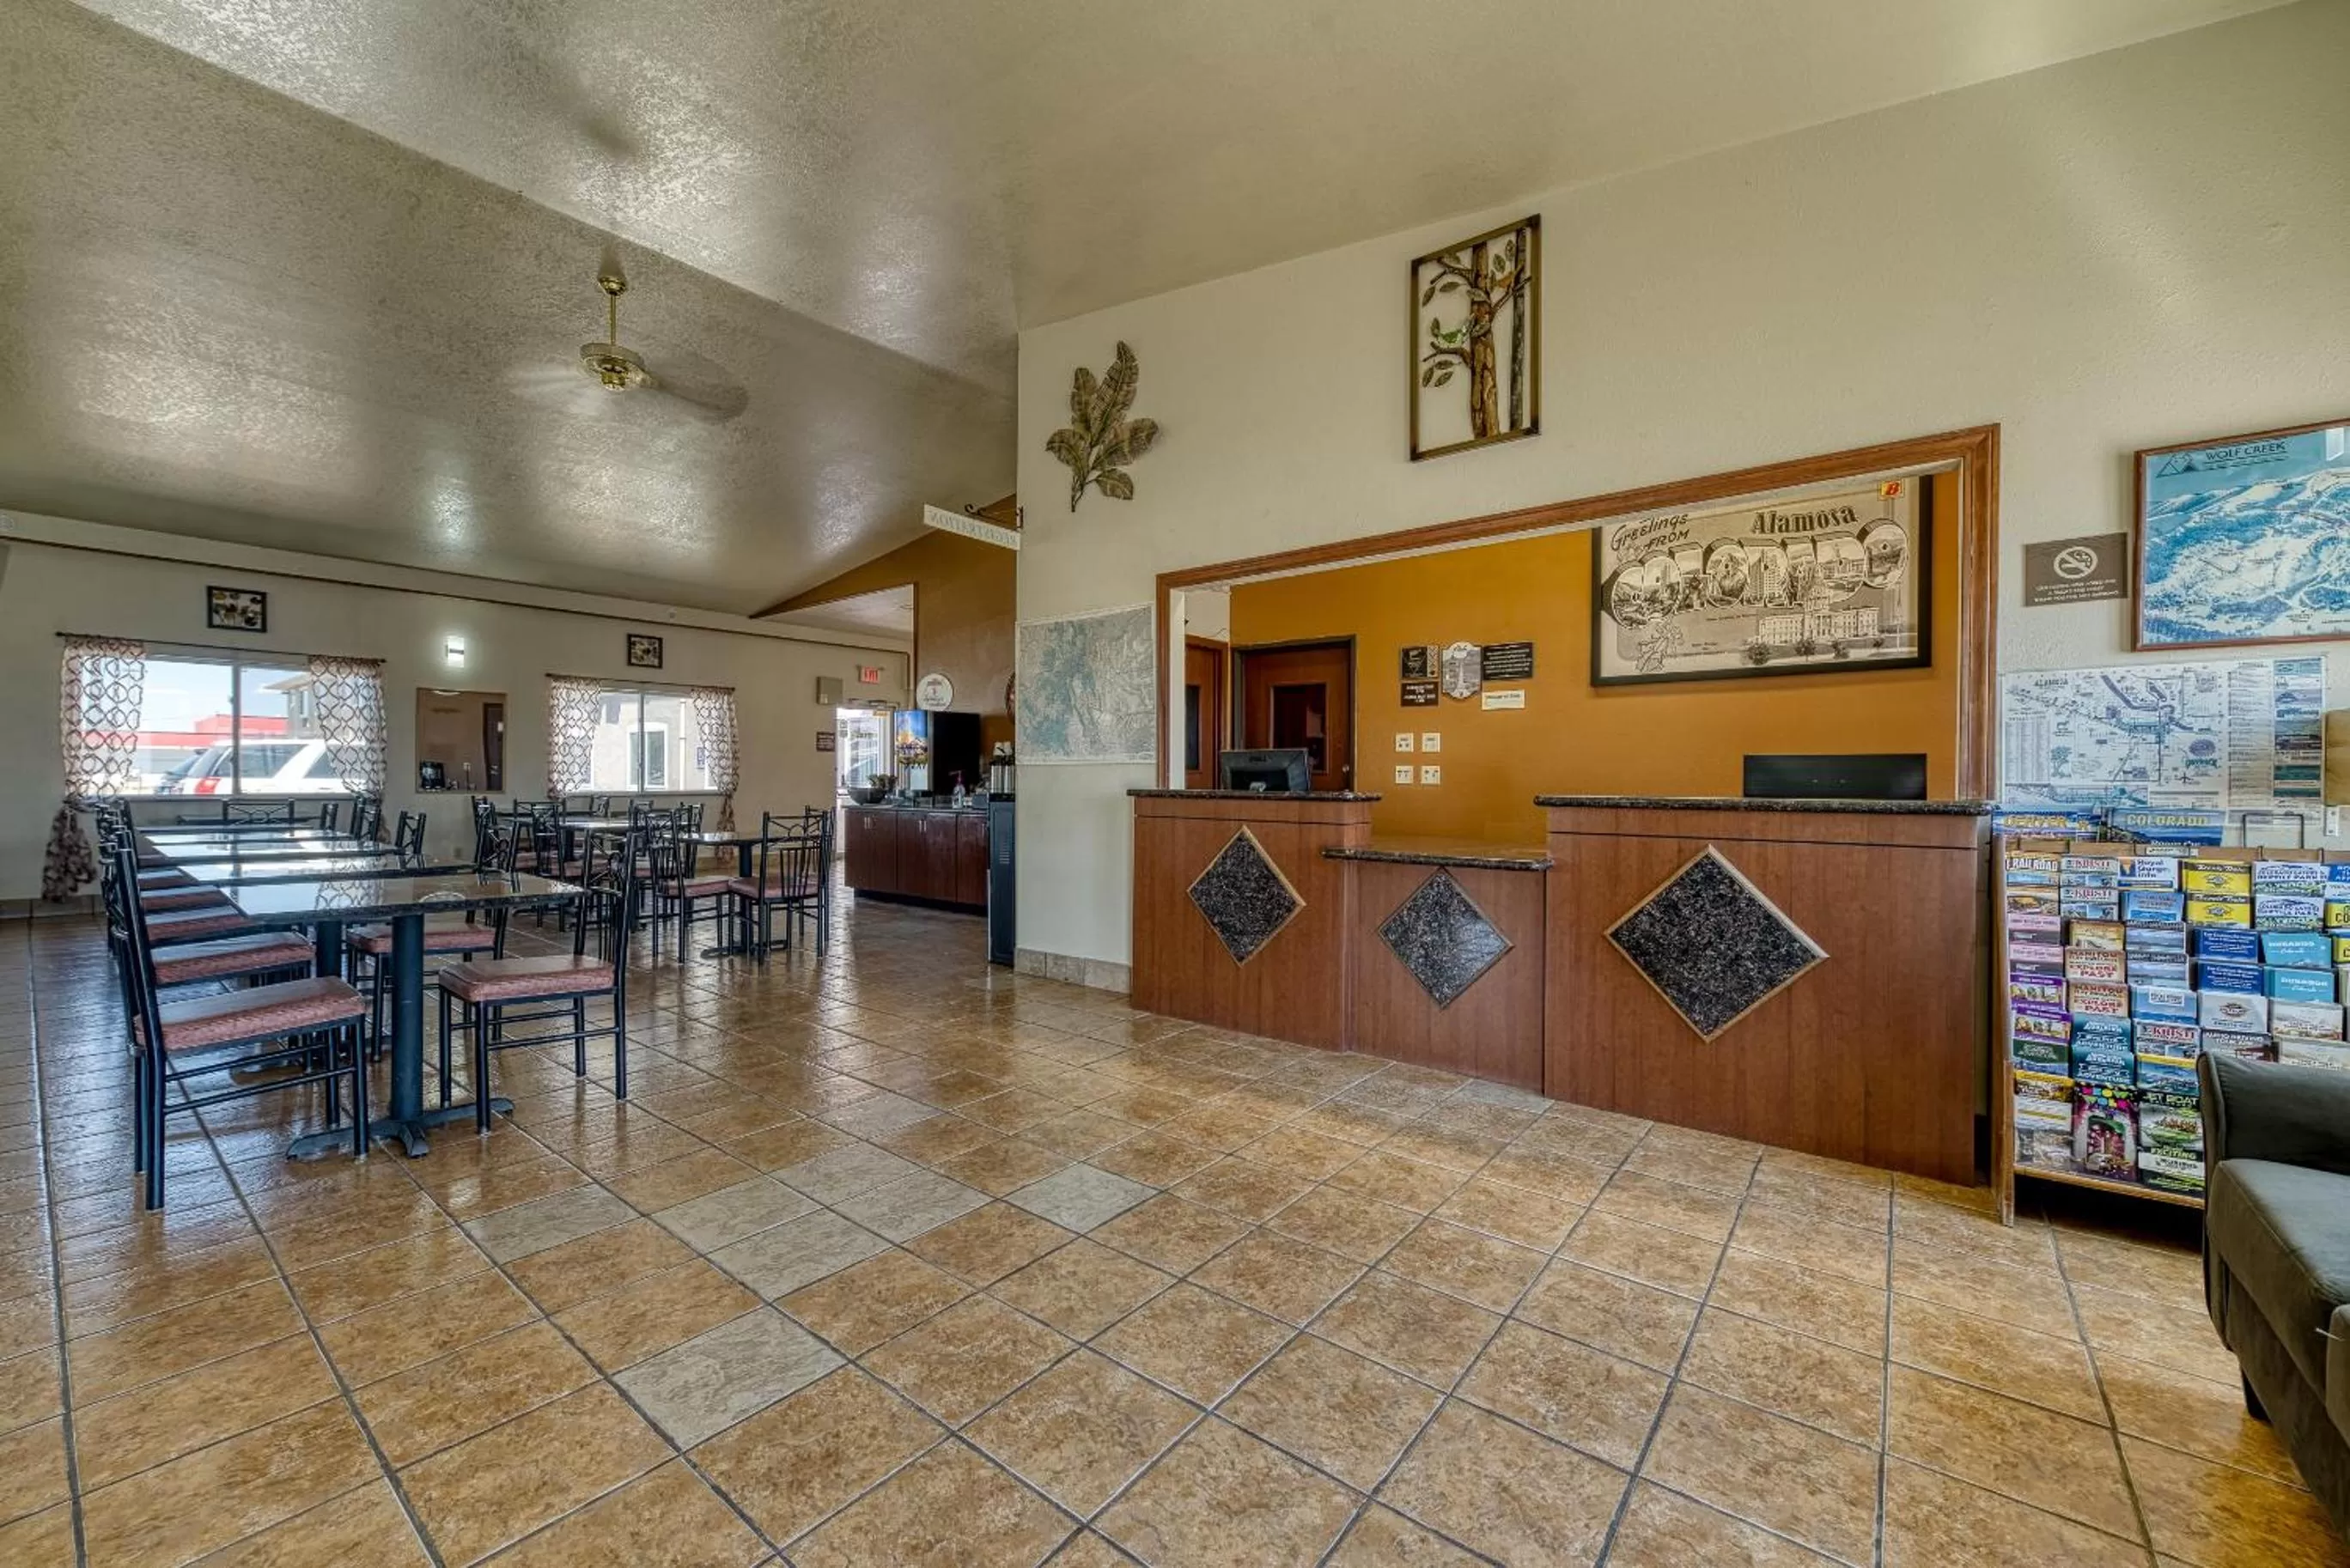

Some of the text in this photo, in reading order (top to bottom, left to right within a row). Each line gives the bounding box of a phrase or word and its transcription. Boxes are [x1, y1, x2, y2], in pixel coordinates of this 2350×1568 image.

[2206, 448, 2242, 461] WOLF
[2244, 441, 2286, 455] CREEK
[1751, 505, 1859, 534] Alamosa
[1610, 514, 1689, 551] Greetings
[1643, 529, 1689, 550] FROM
[2127, 814, 2208, 828] COLORADO
